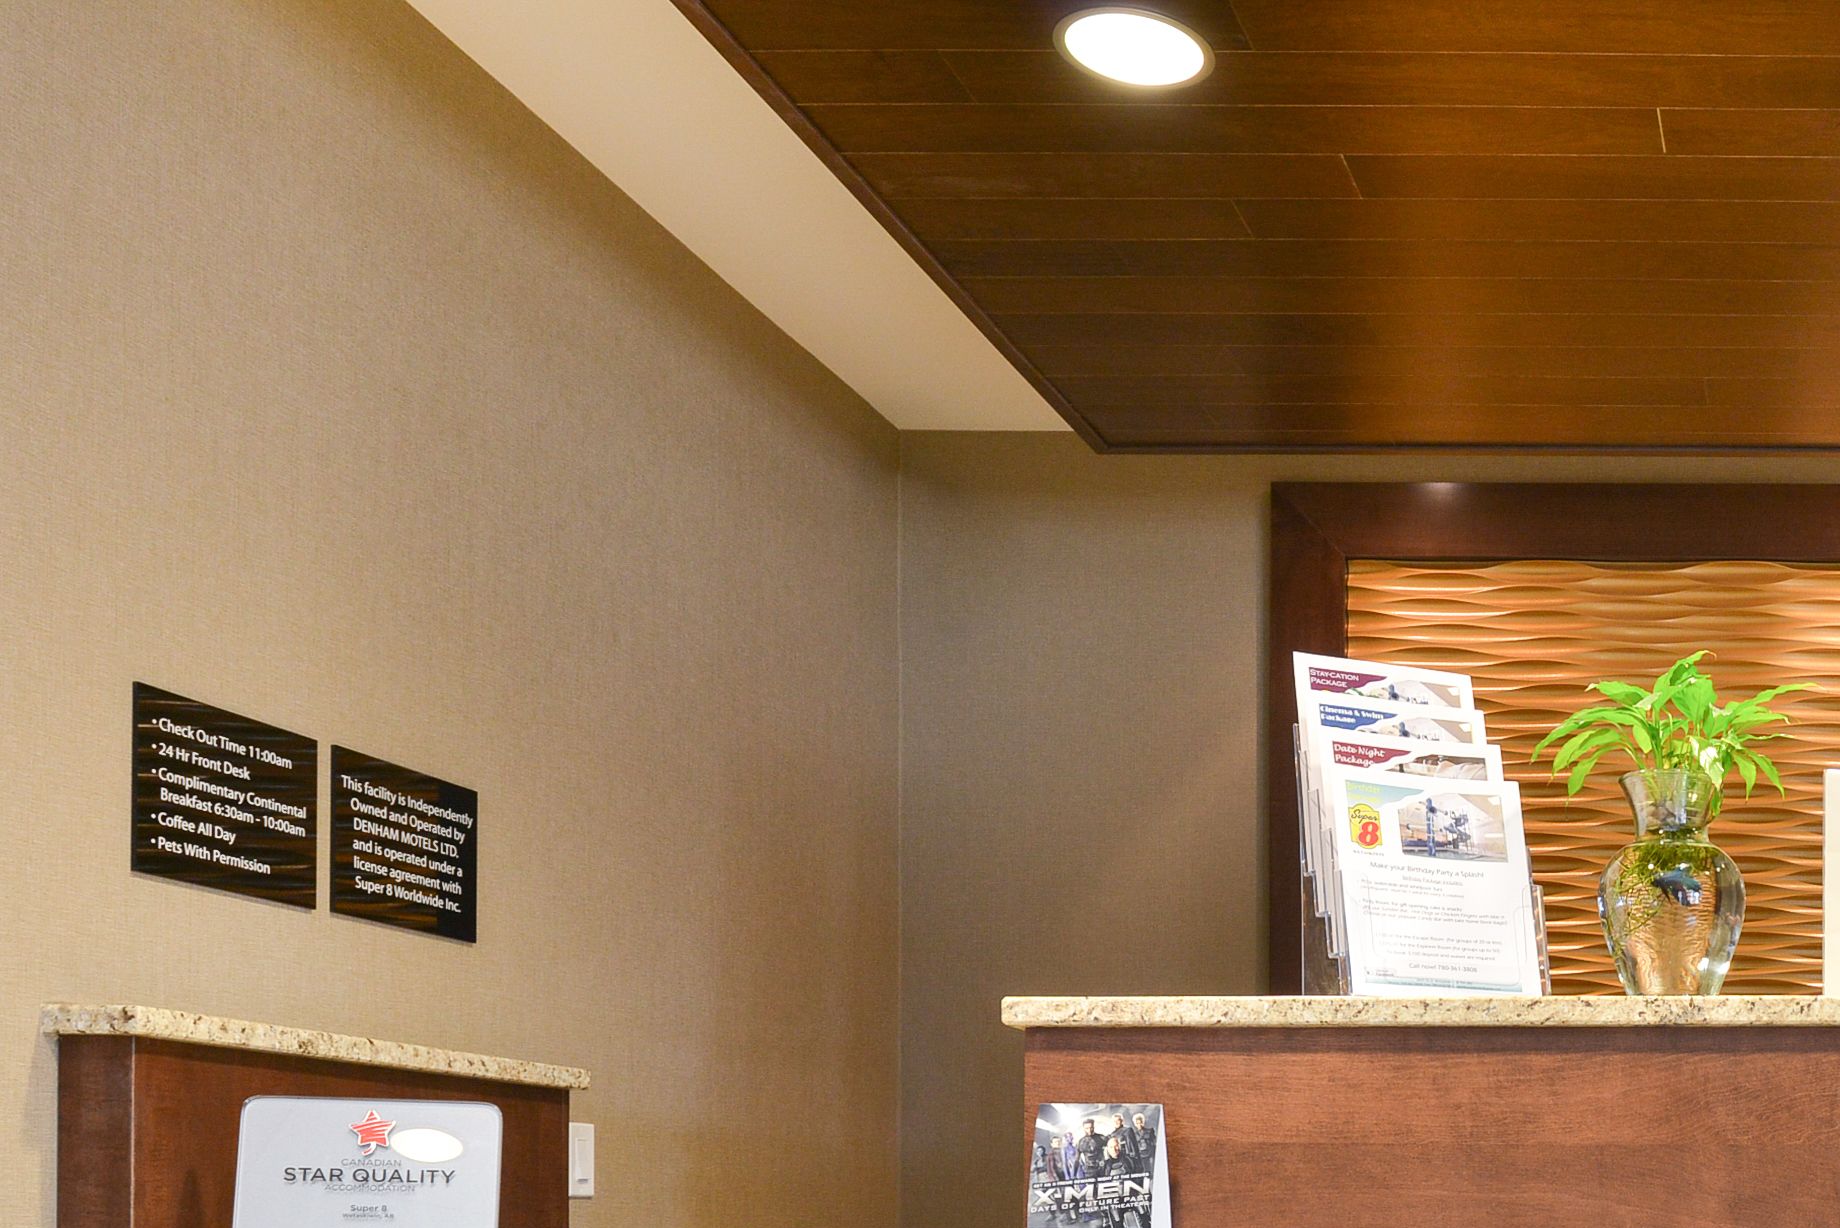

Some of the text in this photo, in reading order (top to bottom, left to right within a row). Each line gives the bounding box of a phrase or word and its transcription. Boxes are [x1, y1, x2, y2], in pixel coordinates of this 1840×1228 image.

[1310, 677, 1348, 688] PACKAGE
[159, 717, 293, 769] Check Out Time 11:00am
[1334, 744, 1386, 758] Date Night
[158, 742, 251, 781] 24 Hr Front Desk
[1335, 754, 1375, 767] Package
[158, 767, 307, 819] Complimentary Continental
[341, 775, 473, 829] This facility is Independently
[158, 811, 236, 845] Coffee All Day
[160, 787, 212, 814] Breakfast
[214, 802, 254, 824] 6:30am
[263, 816, 306, 838] 10:00am
[350, 797, 465, 844] Owned and Operated by
[1351, 809, 1378, 824] Super
[353, 817, 459, 859] DENHAM MOTELS LTD.
[1358, 821, 1379, 846] 8
[157, 836, 271, 875] Pets With Permission
[352, 839, 463, 877] and is operated under a
[1370, 862, 1388, 870] Make
[1390, 864, 1405, 872] your
[1407, 866, 1435, 876] Birthday
[1436, 868, 1454, 877] Party
[1461, 870, 1484, 878] Splash!
[353, 855, 462, 895] license agreement with
[355, 876, 461, 913] Super 8 Worldwide Inc.
[283, 1167, 456, 1184] STAR QUALITY
[341, 1158, 402, 1167] CANADIAN
[324, 1184, 416, 1192] ACCOMMODATION
[1030, 1204, 1057, 1213] DAYS
[1079, 1198, 1120, 1207] FUTURE
[1124, 1194, 1150, 1202] PAST
[1033, 1177, 1151, 1206] X-MEN
[350, 1204, 387, 1213] Super 8
